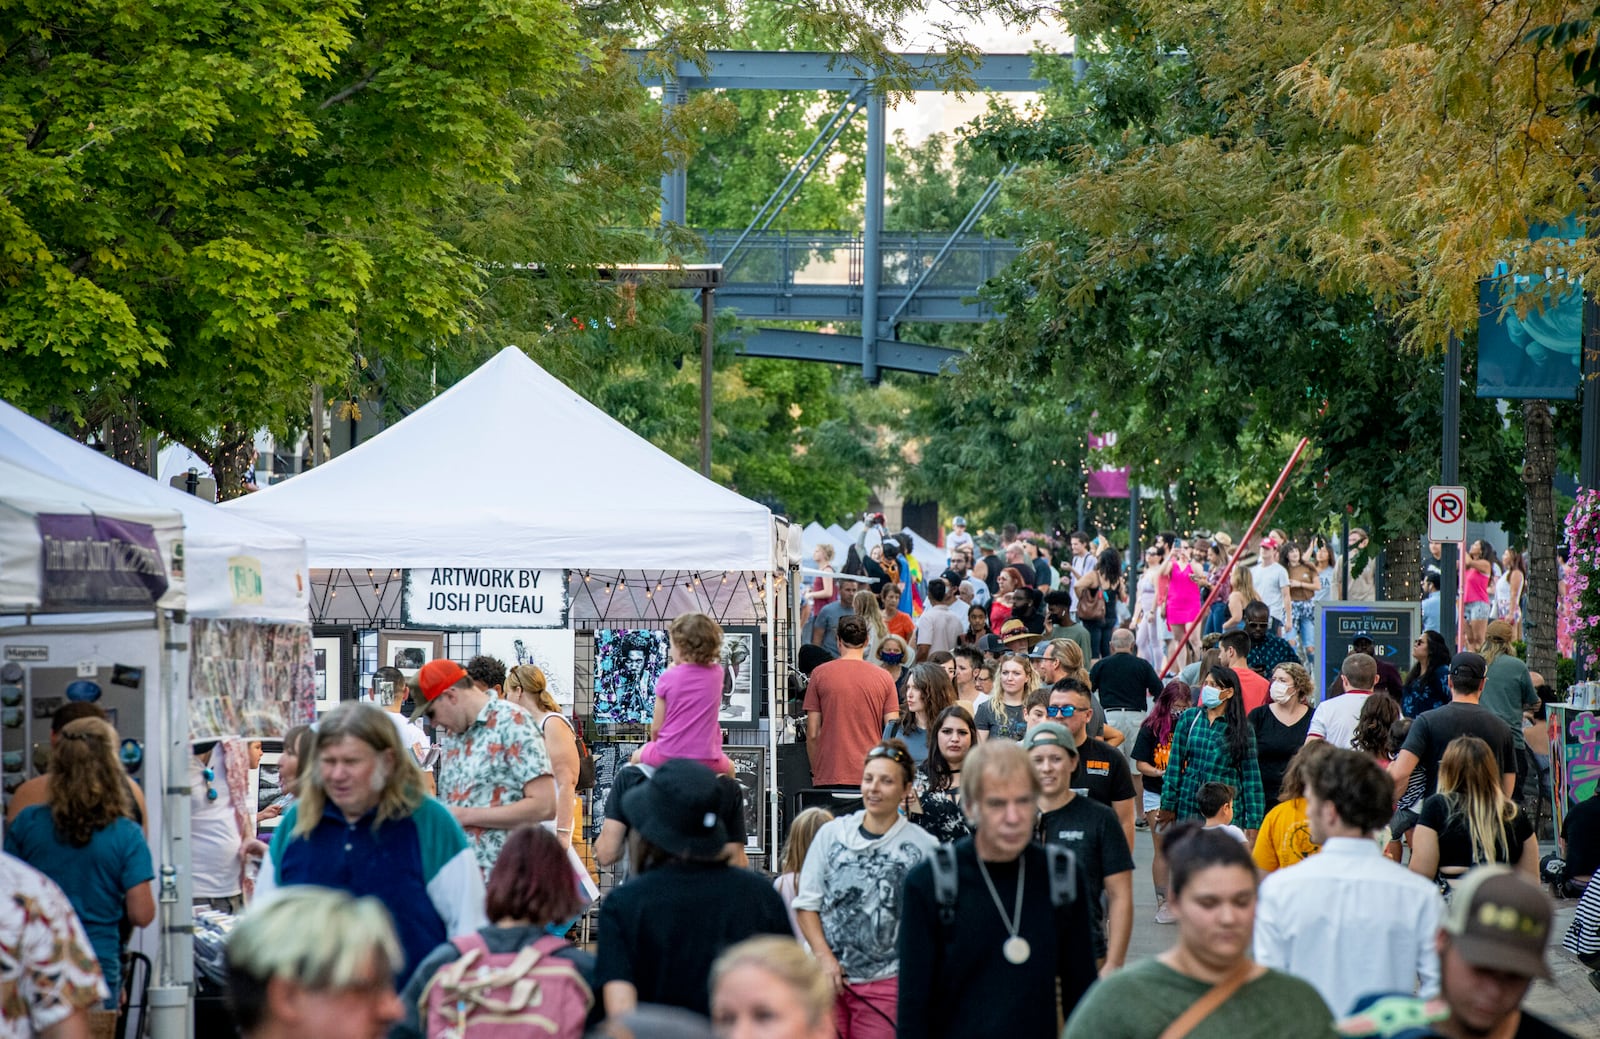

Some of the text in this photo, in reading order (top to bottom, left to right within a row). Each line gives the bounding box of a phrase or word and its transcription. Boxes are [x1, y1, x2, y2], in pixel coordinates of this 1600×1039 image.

[431, 568, 541, 588] ARTWORK BY
[427, 592, 544, 613] JOSH PUGEAU
[1342, 621, 1394, 631] GATEWAY
[7, 648, 48, 657] Magnets
